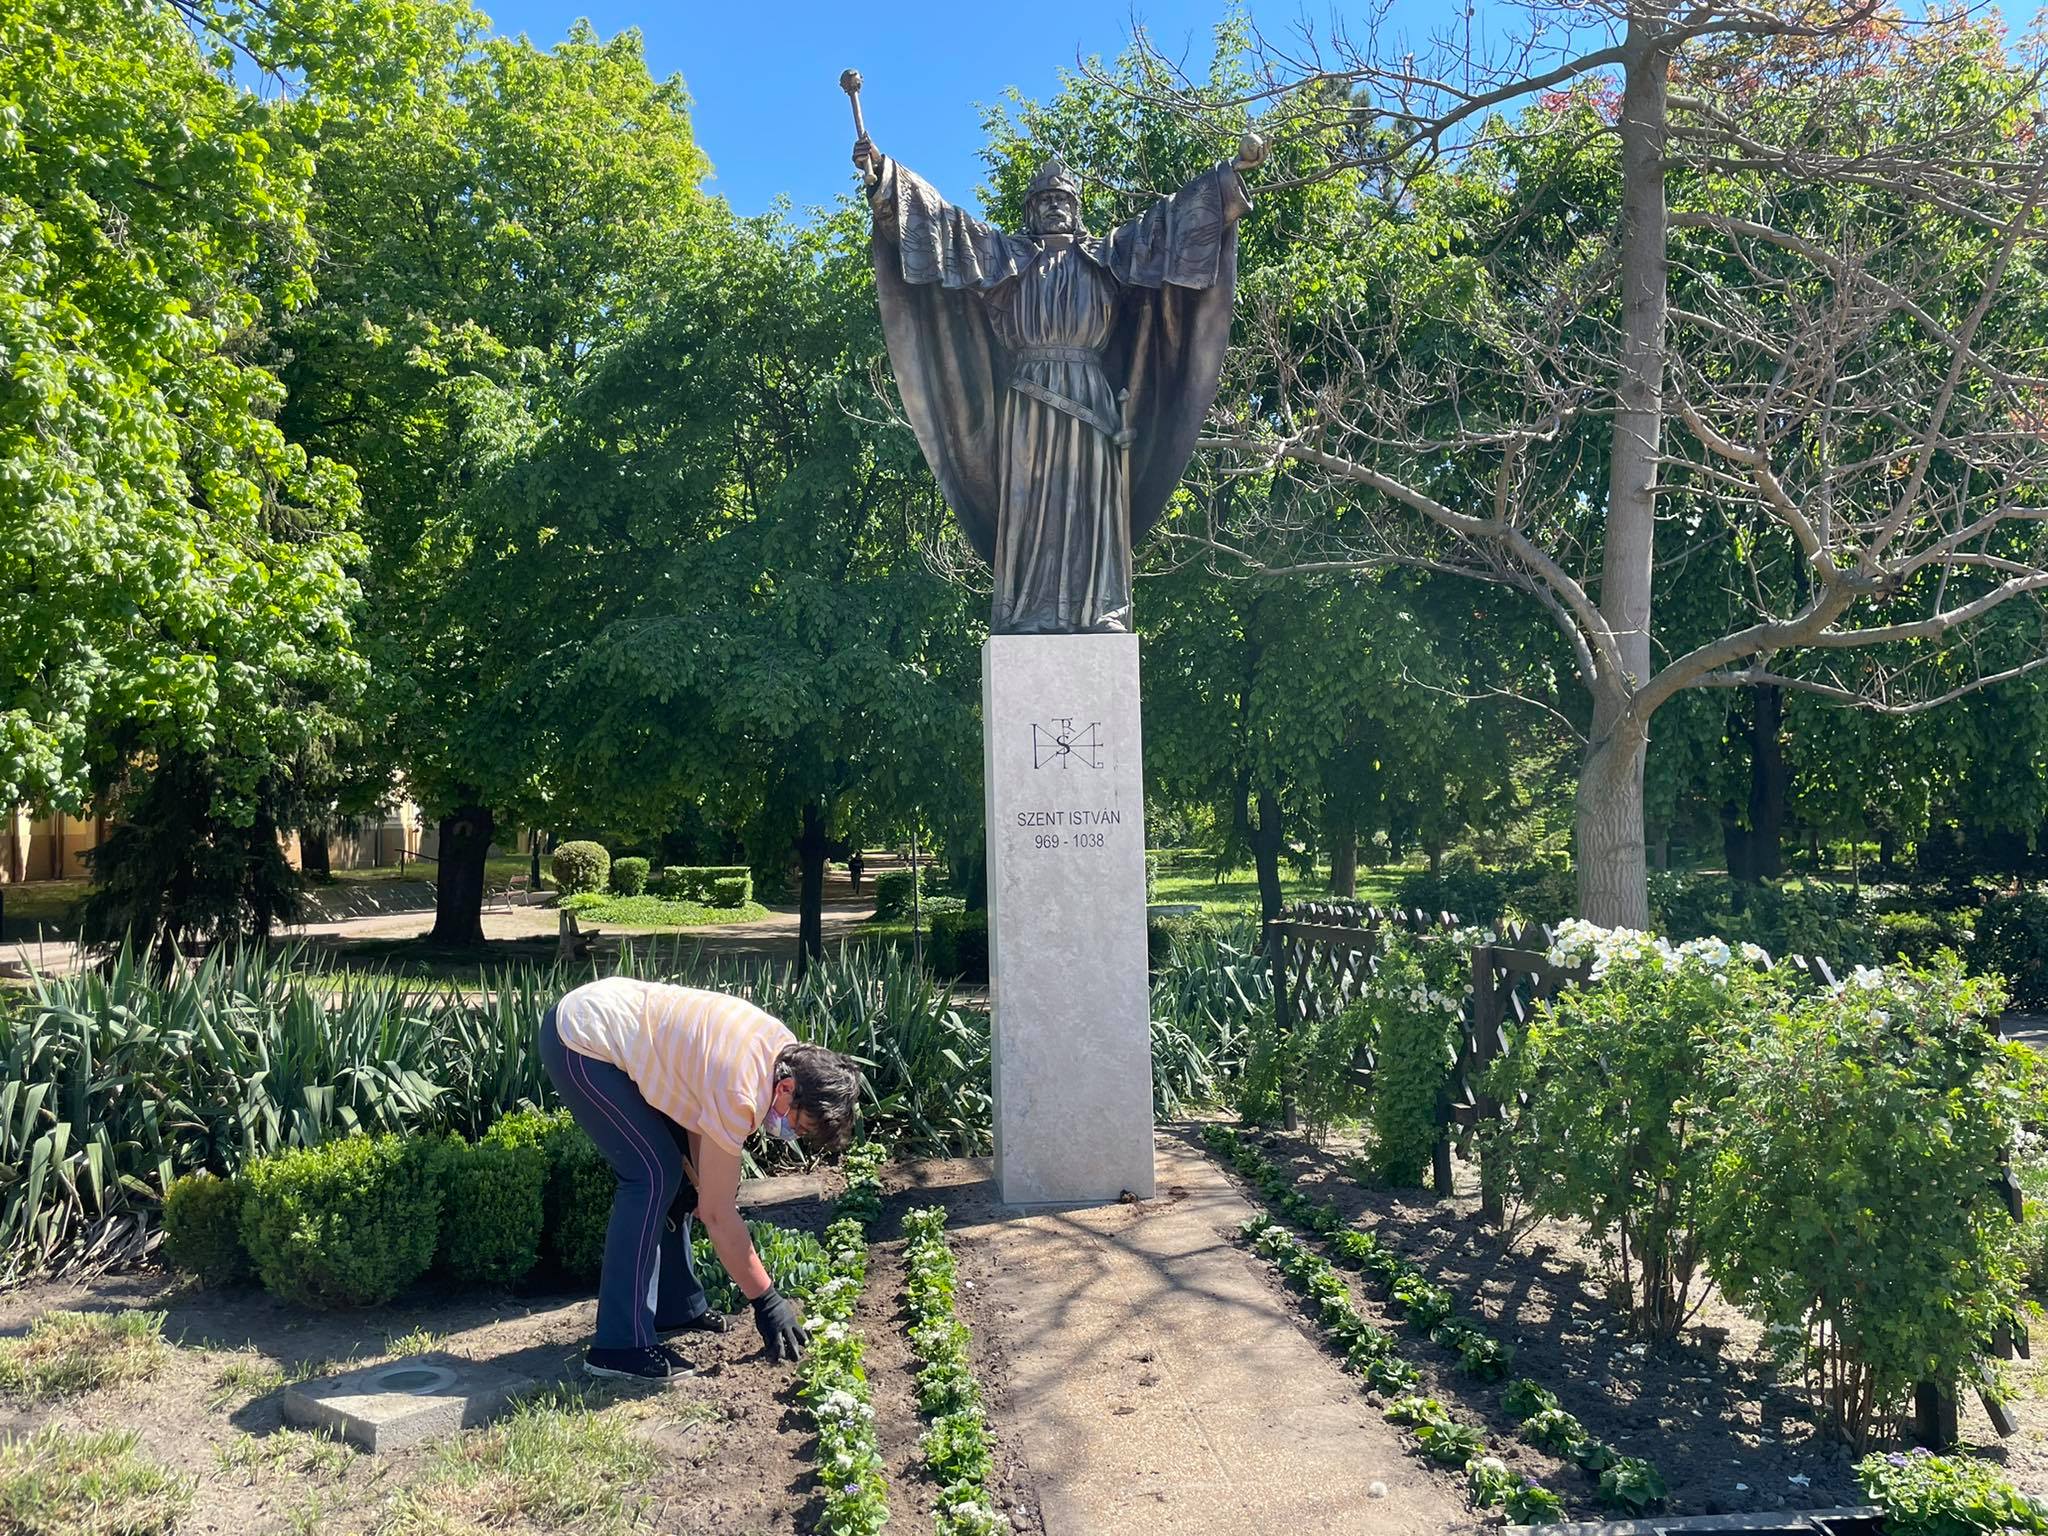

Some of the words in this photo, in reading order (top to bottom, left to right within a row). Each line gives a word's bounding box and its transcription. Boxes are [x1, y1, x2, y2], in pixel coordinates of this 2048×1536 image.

[1017, 811, 1064, 826] SZENT
[1069, 808, 1120, 825] ISTVÁN
[1035, 834, 1060, 849] 969
[1072, 833, 1105, 848] 1038
